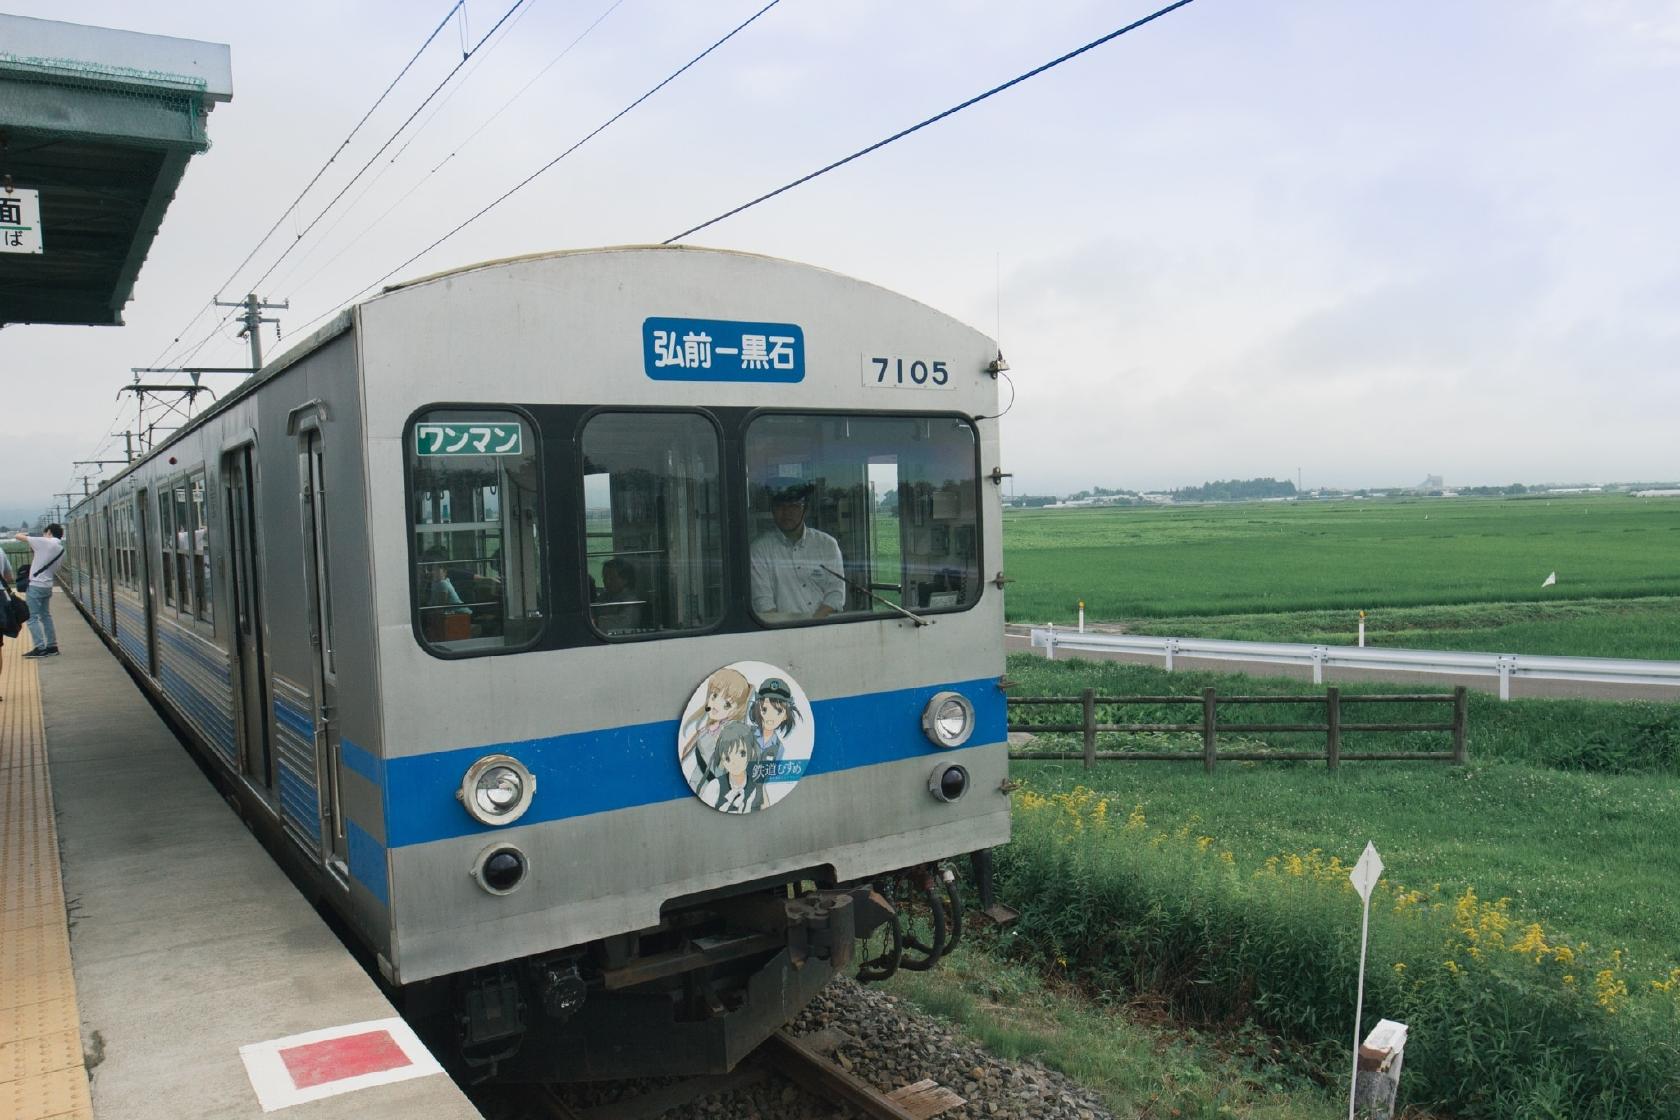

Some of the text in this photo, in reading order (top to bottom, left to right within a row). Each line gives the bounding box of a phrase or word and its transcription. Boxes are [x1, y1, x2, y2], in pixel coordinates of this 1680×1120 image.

[872, 358, 949, 386] 7105
[420, 427, 517, 452] ワンマン
[752, 762, 802, 781] 鉄道むすめ
